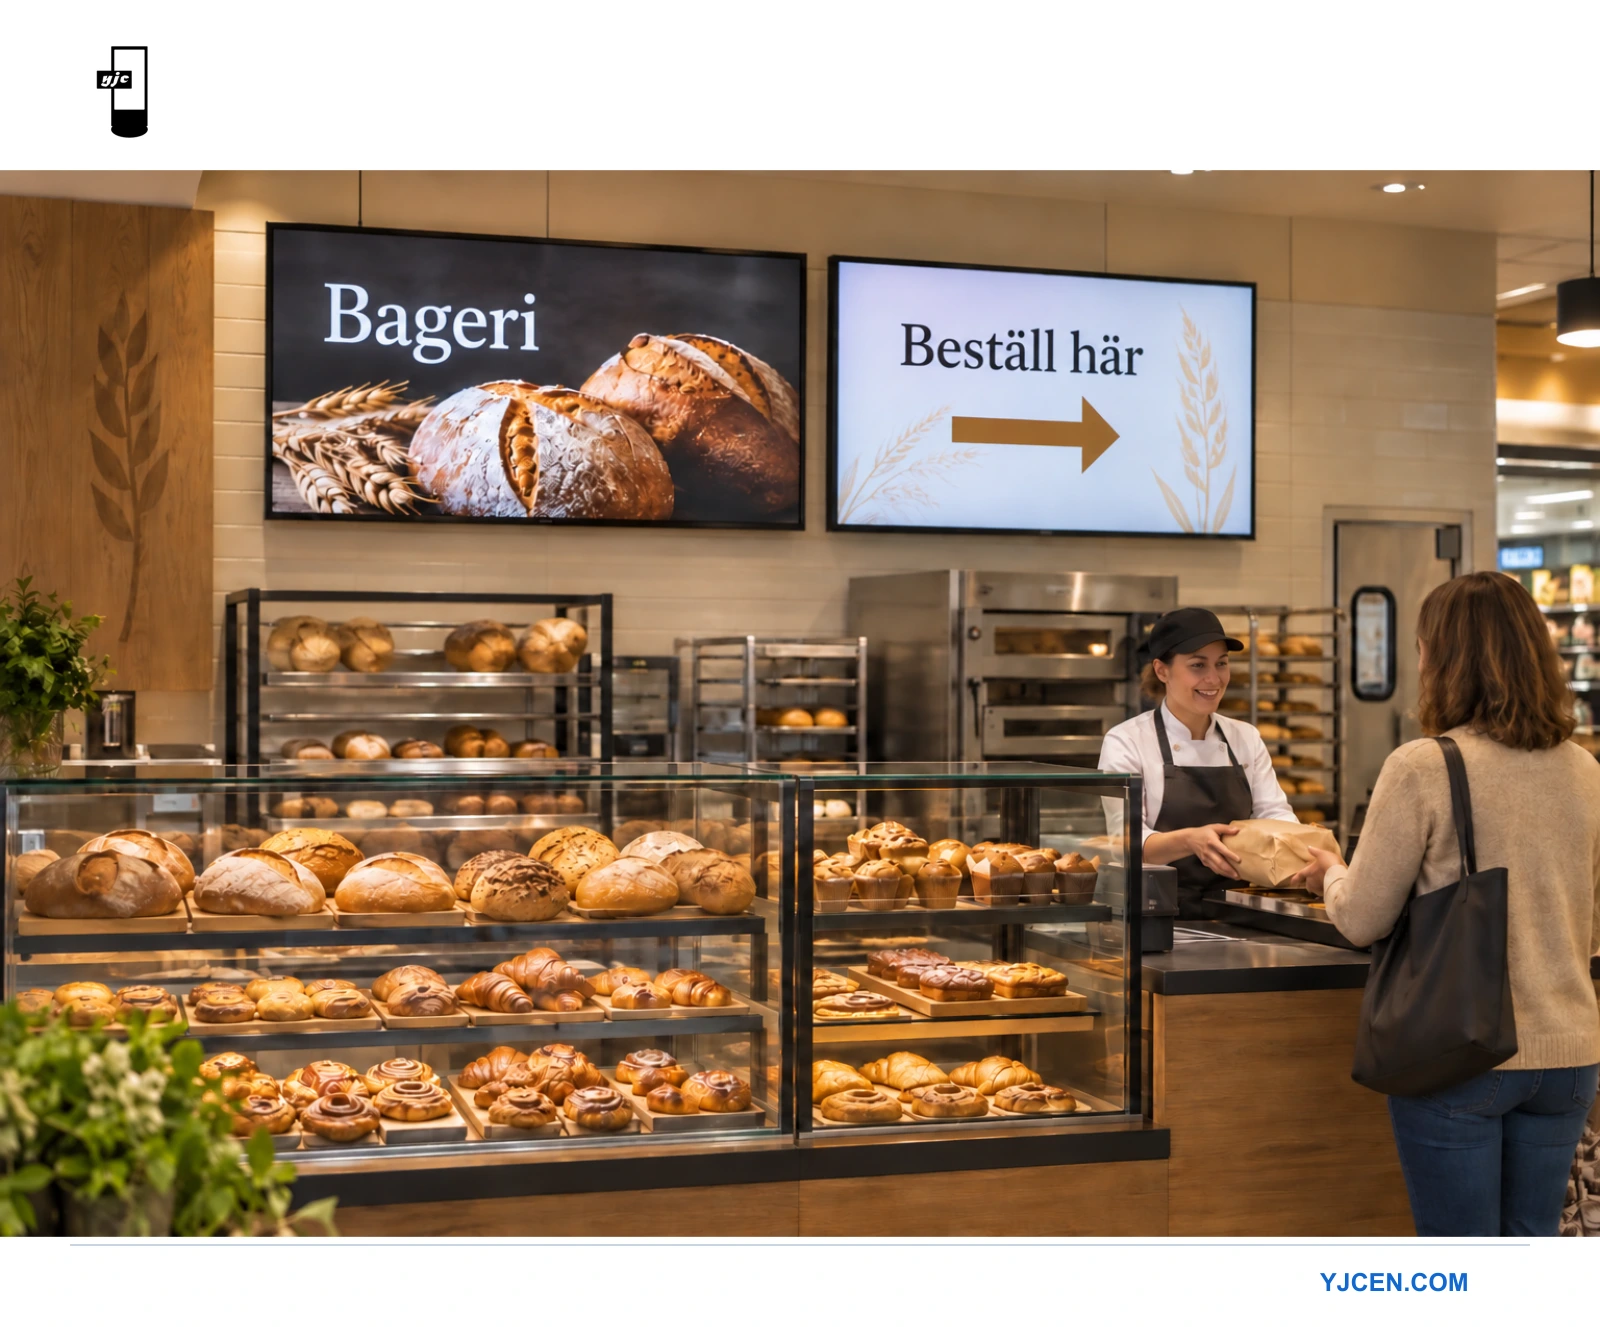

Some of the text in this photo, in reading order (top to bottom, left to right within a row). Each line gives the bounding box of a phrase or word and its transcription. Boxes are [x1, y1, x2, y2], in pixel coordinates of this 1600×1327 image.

[323, 282, 540, 365] Bageri
[900, 323, 1144, 376] Beställ här
